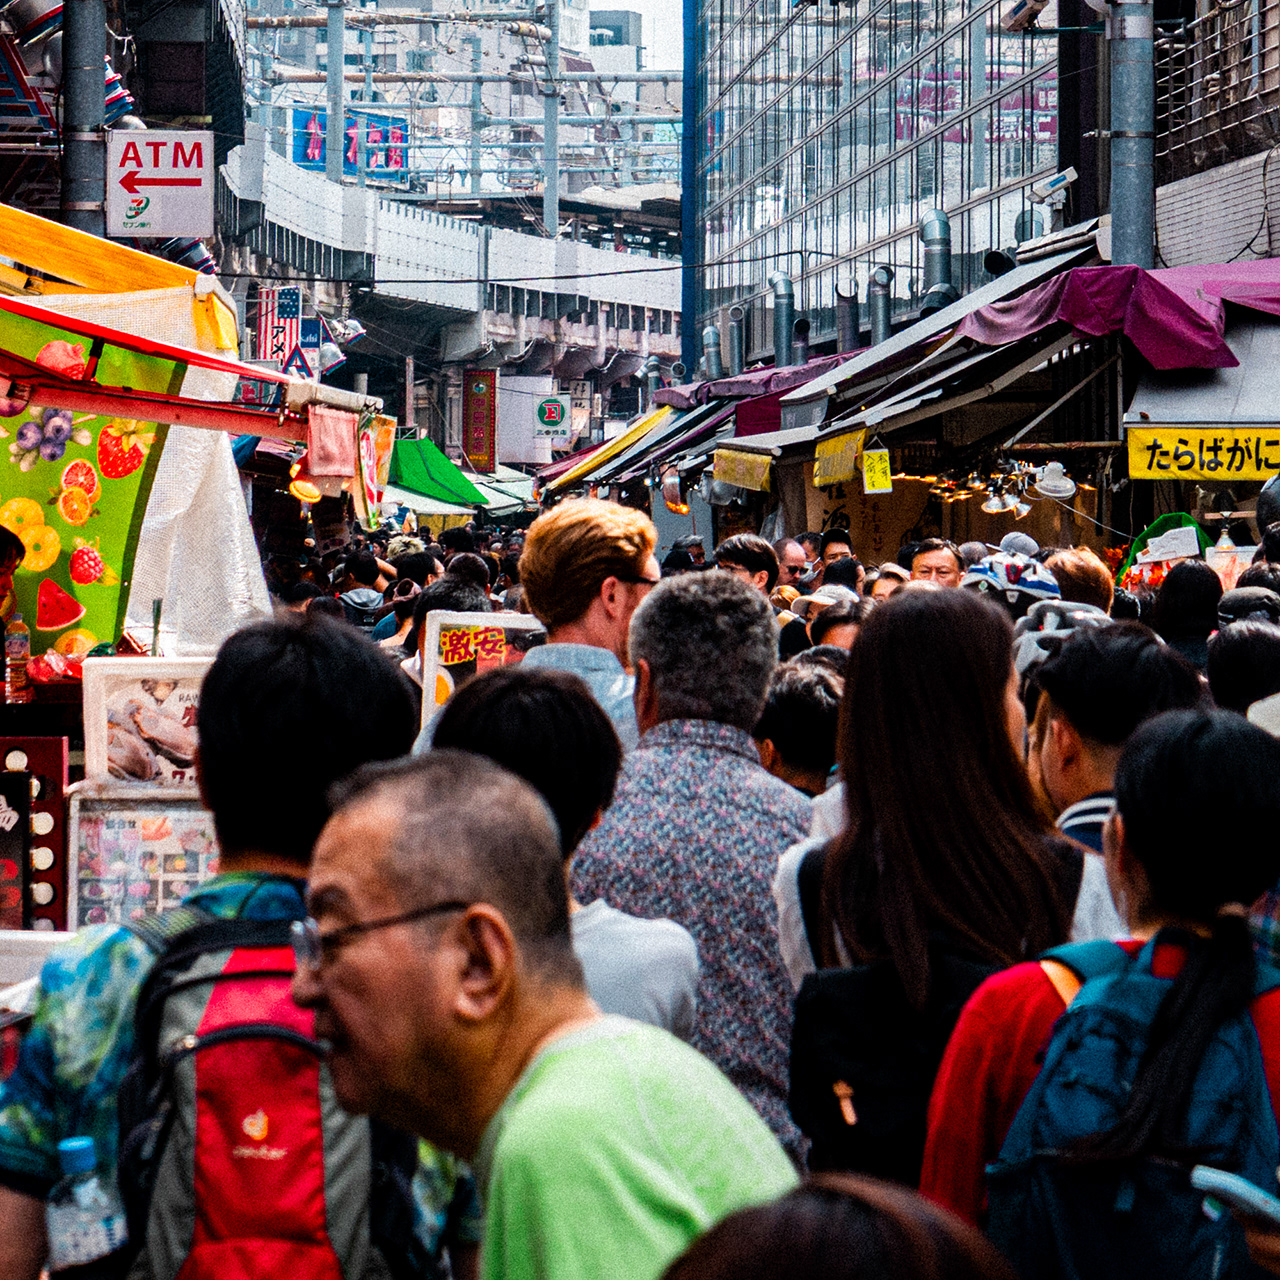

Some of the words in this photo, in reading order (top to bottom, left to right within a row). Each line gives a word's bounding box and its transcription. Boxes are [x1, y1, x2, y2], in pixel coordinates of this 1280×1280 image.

[118, 141, 203, 168] ATM
[1146, 436, 1280, 472] たらばがに
[441, 627, 505, 663] 激安
